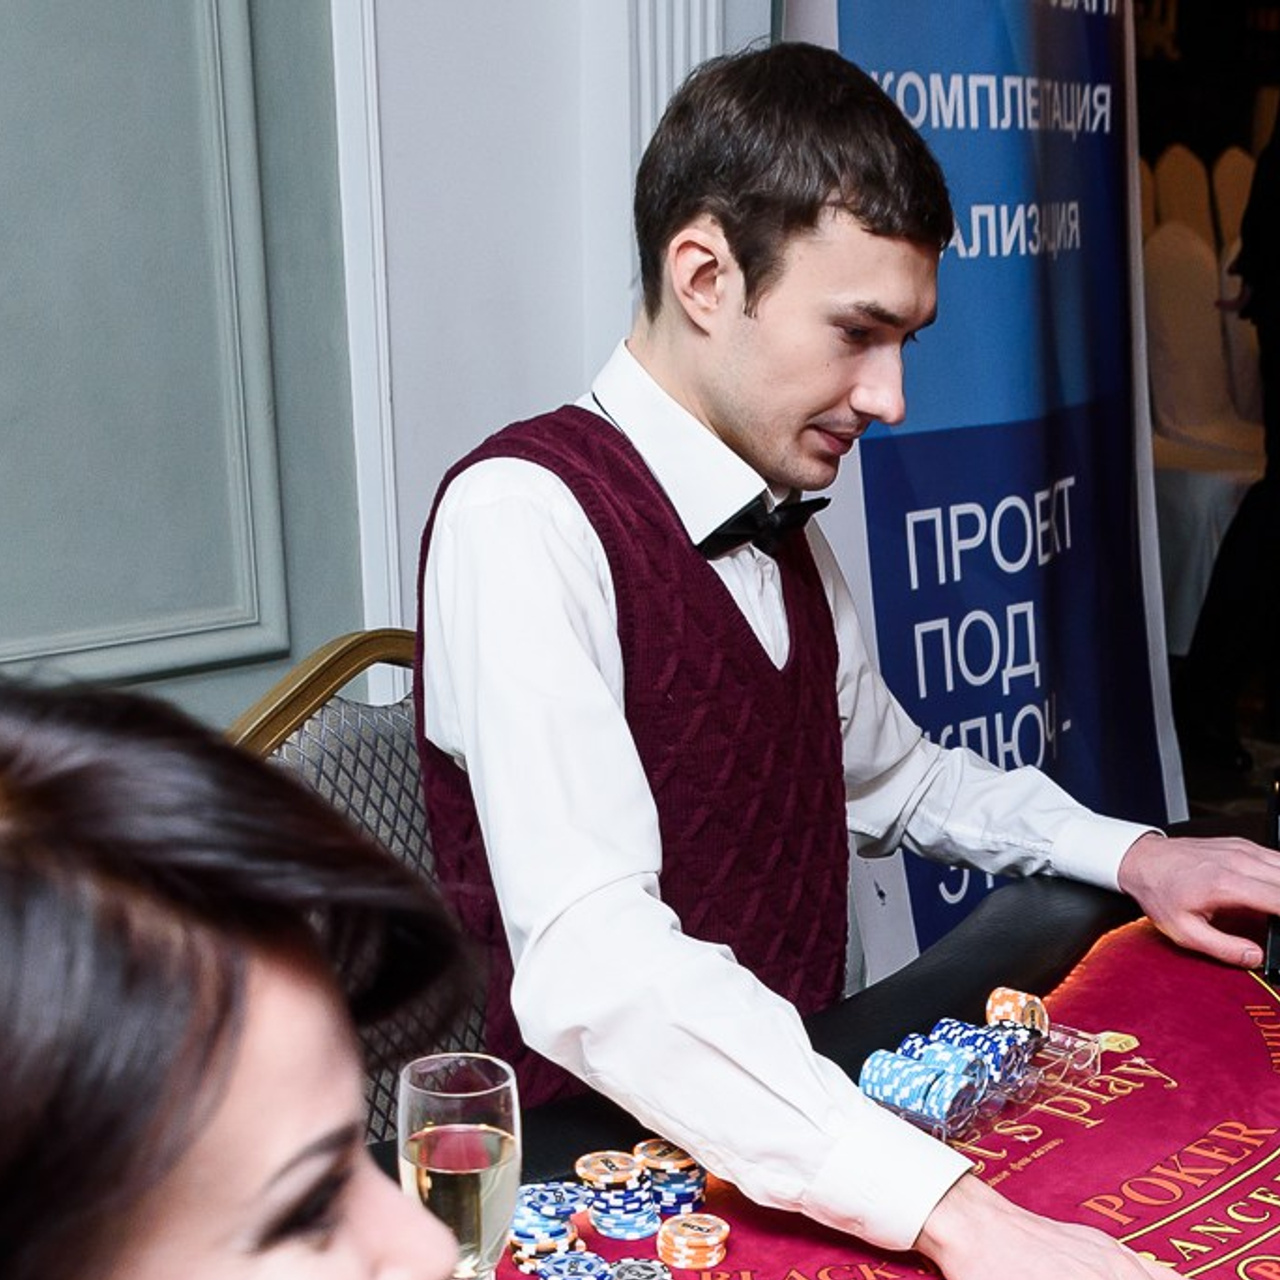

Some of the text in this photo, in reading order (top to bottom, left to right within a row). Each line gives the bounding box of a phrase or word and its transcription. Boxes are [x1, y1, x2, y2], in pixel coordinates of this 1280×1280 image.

[871, 70, 1112, 142] ОМПЛЕТАЦИЯ
[938, 202, 1081, 260] АЛИЗАЦИЯ
[905, 476, 1076, 590] ПРОЕКТ
[914, 601, 1040, 698] ПОД
[1081, 1121, 1279, 1226] POKER
